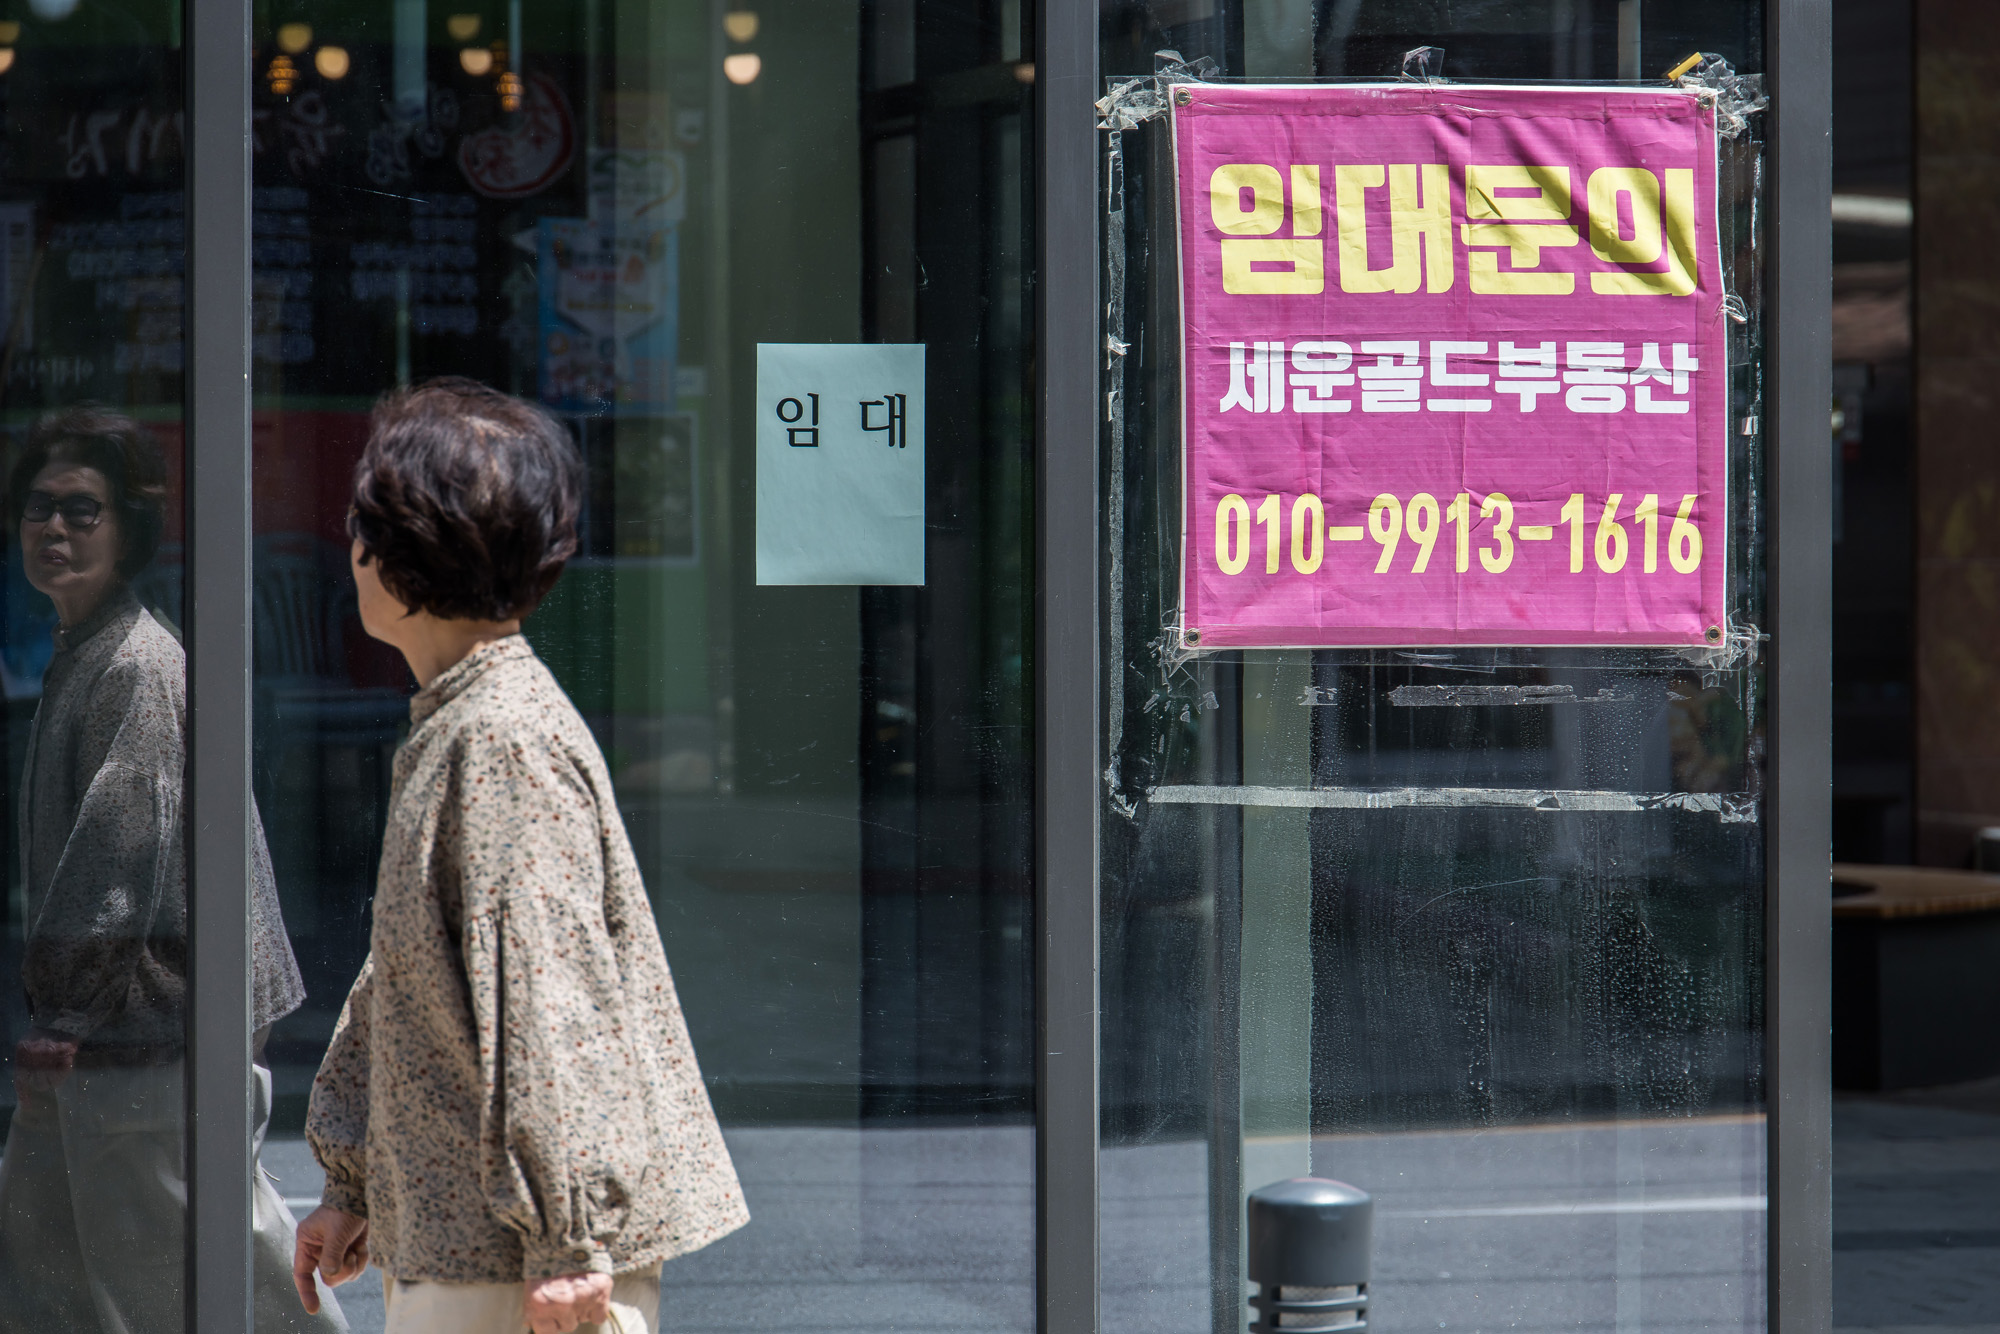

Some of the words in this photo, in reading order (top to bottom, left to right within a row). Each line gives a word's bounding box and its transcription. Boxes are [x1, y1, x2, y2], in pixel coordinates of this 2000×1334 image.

[1210, 163, 1698, 296] 임대문의
[1219, 340, 1699, 414] 세운골드부동산
[1214, 492, 1703, 575] 010-9913-1616
